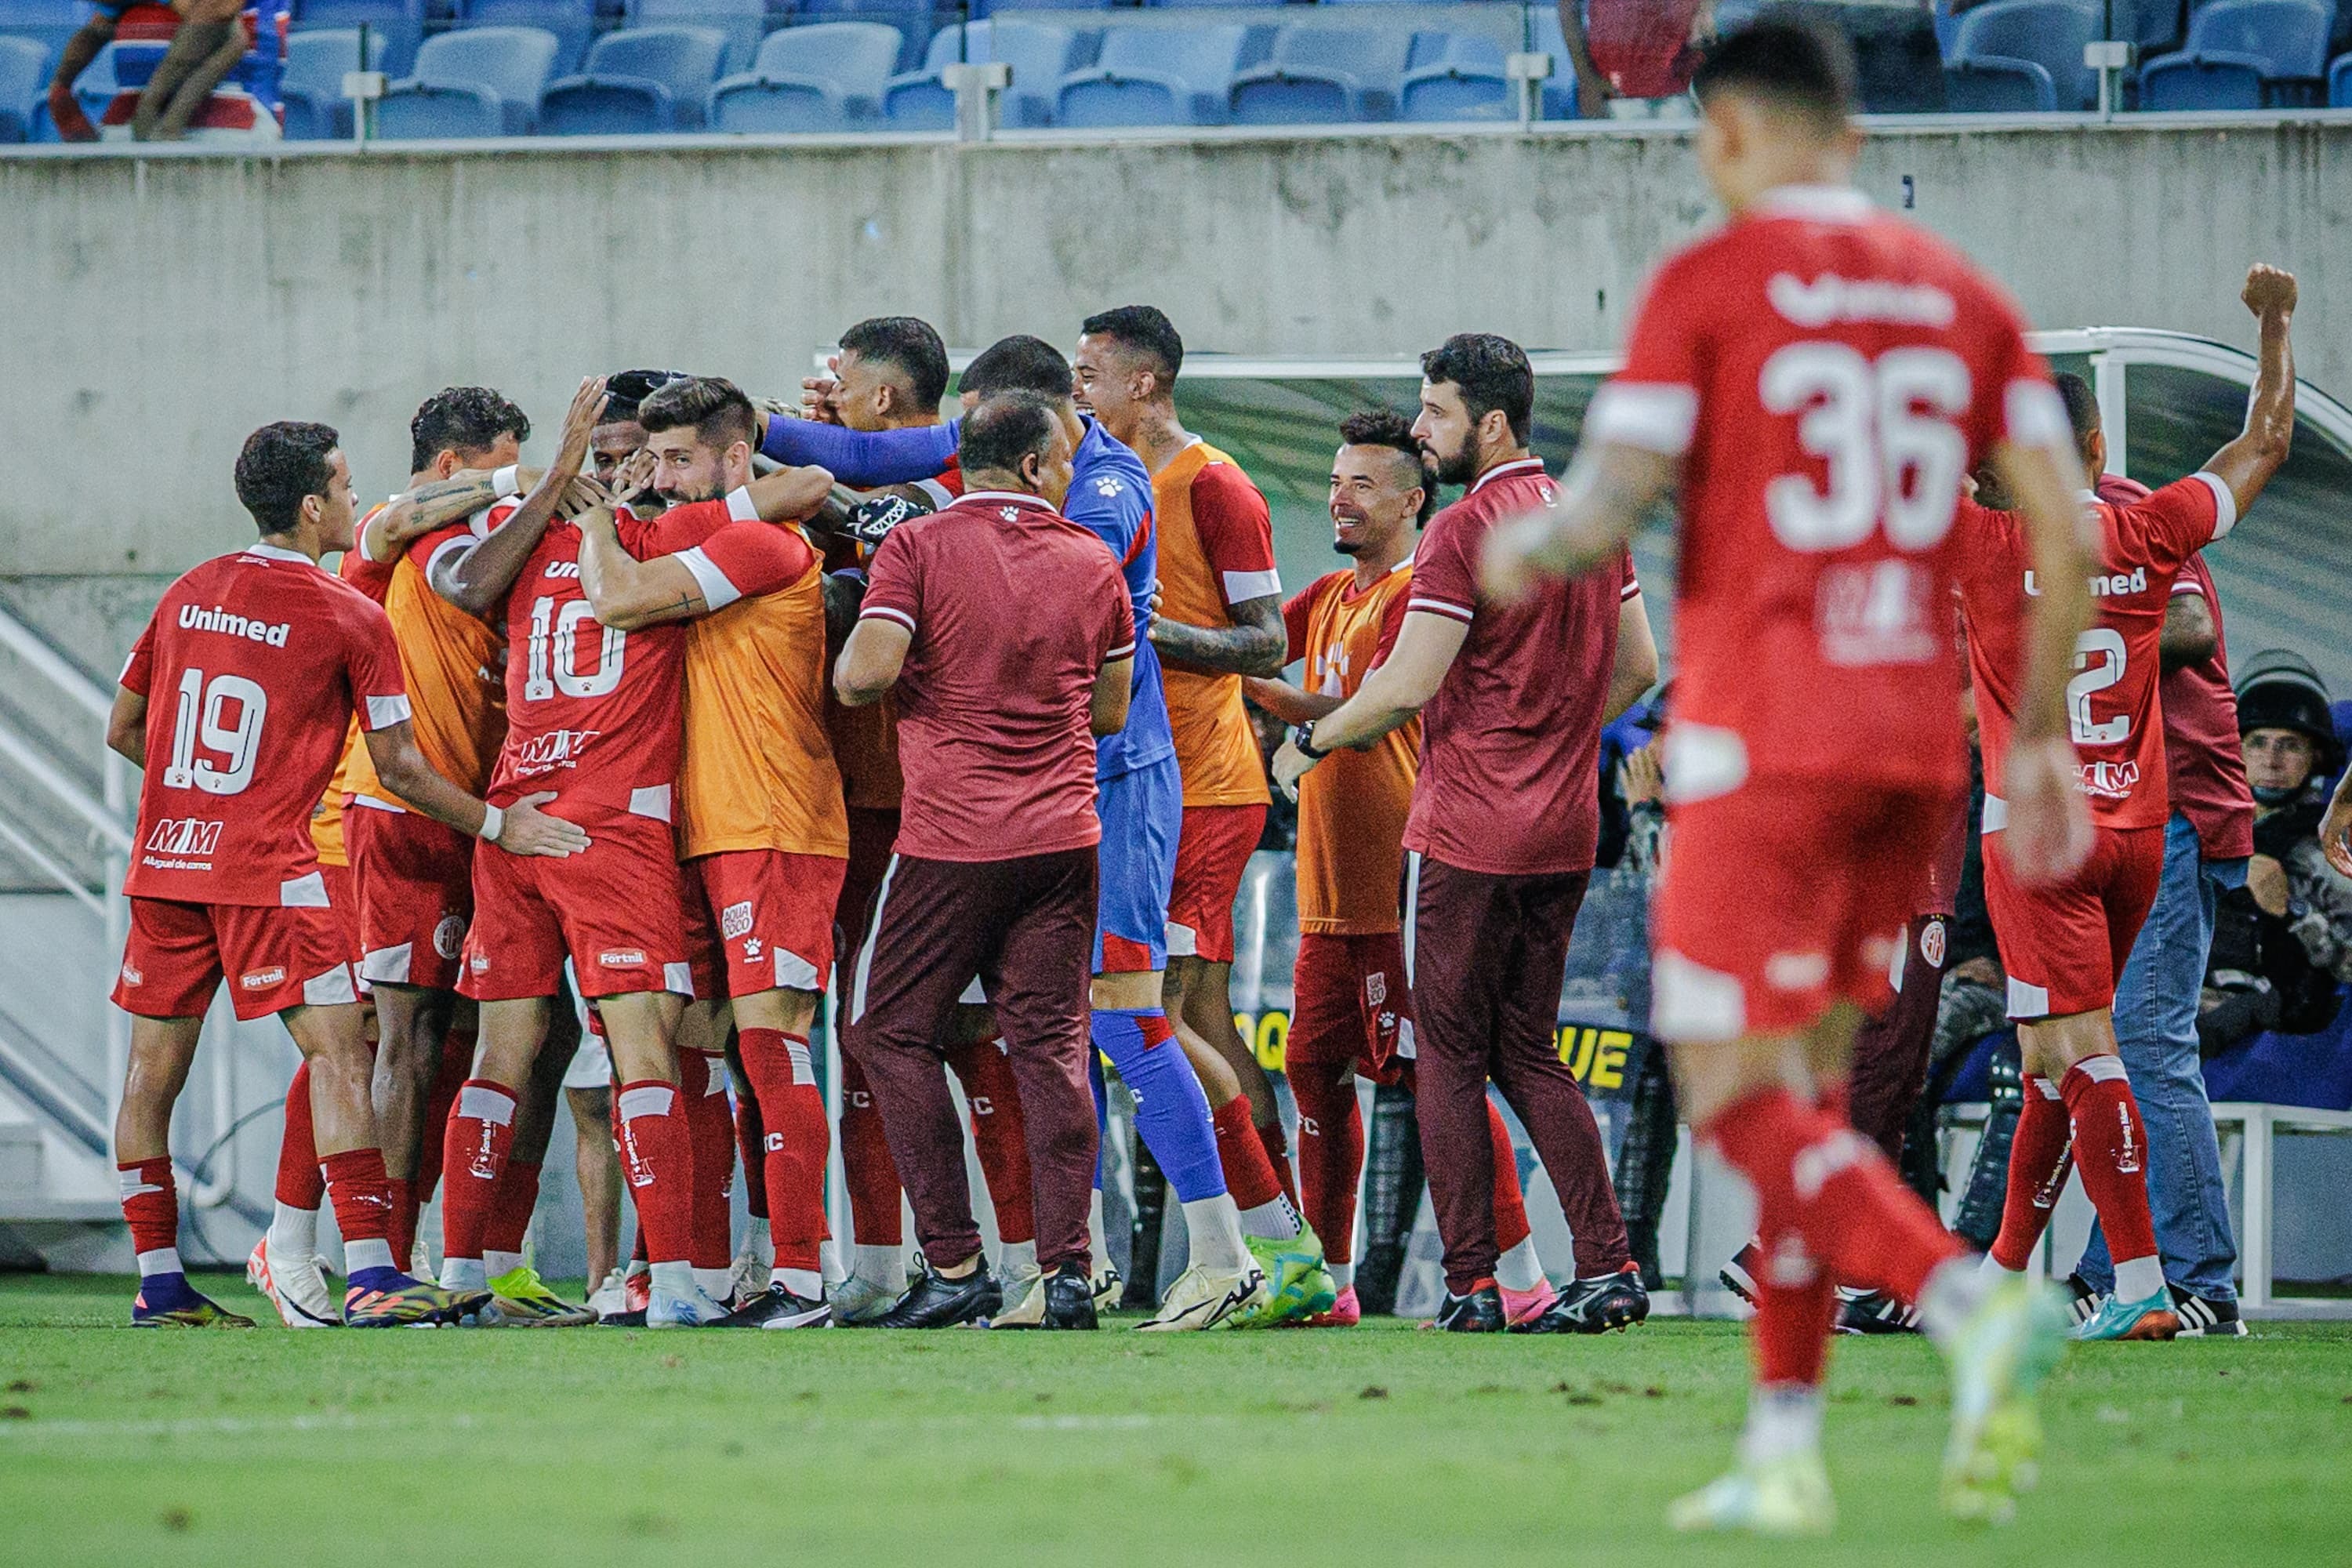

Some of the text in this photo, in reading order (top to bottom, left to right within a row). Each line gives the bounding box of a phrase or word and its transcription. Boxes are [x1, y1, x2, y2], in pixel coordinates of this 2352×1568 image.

[1759, 341, 1973, 553] 36
[178, 604, 290, 648] Unimed
[524, 596, 626, 702] 10
[162, 667, 267, 795] 19
[2066, 627, 2130, 745] 2
[242, 968, 285, 988] Fortnil
[599, 953, 644, 964] Fortnil
